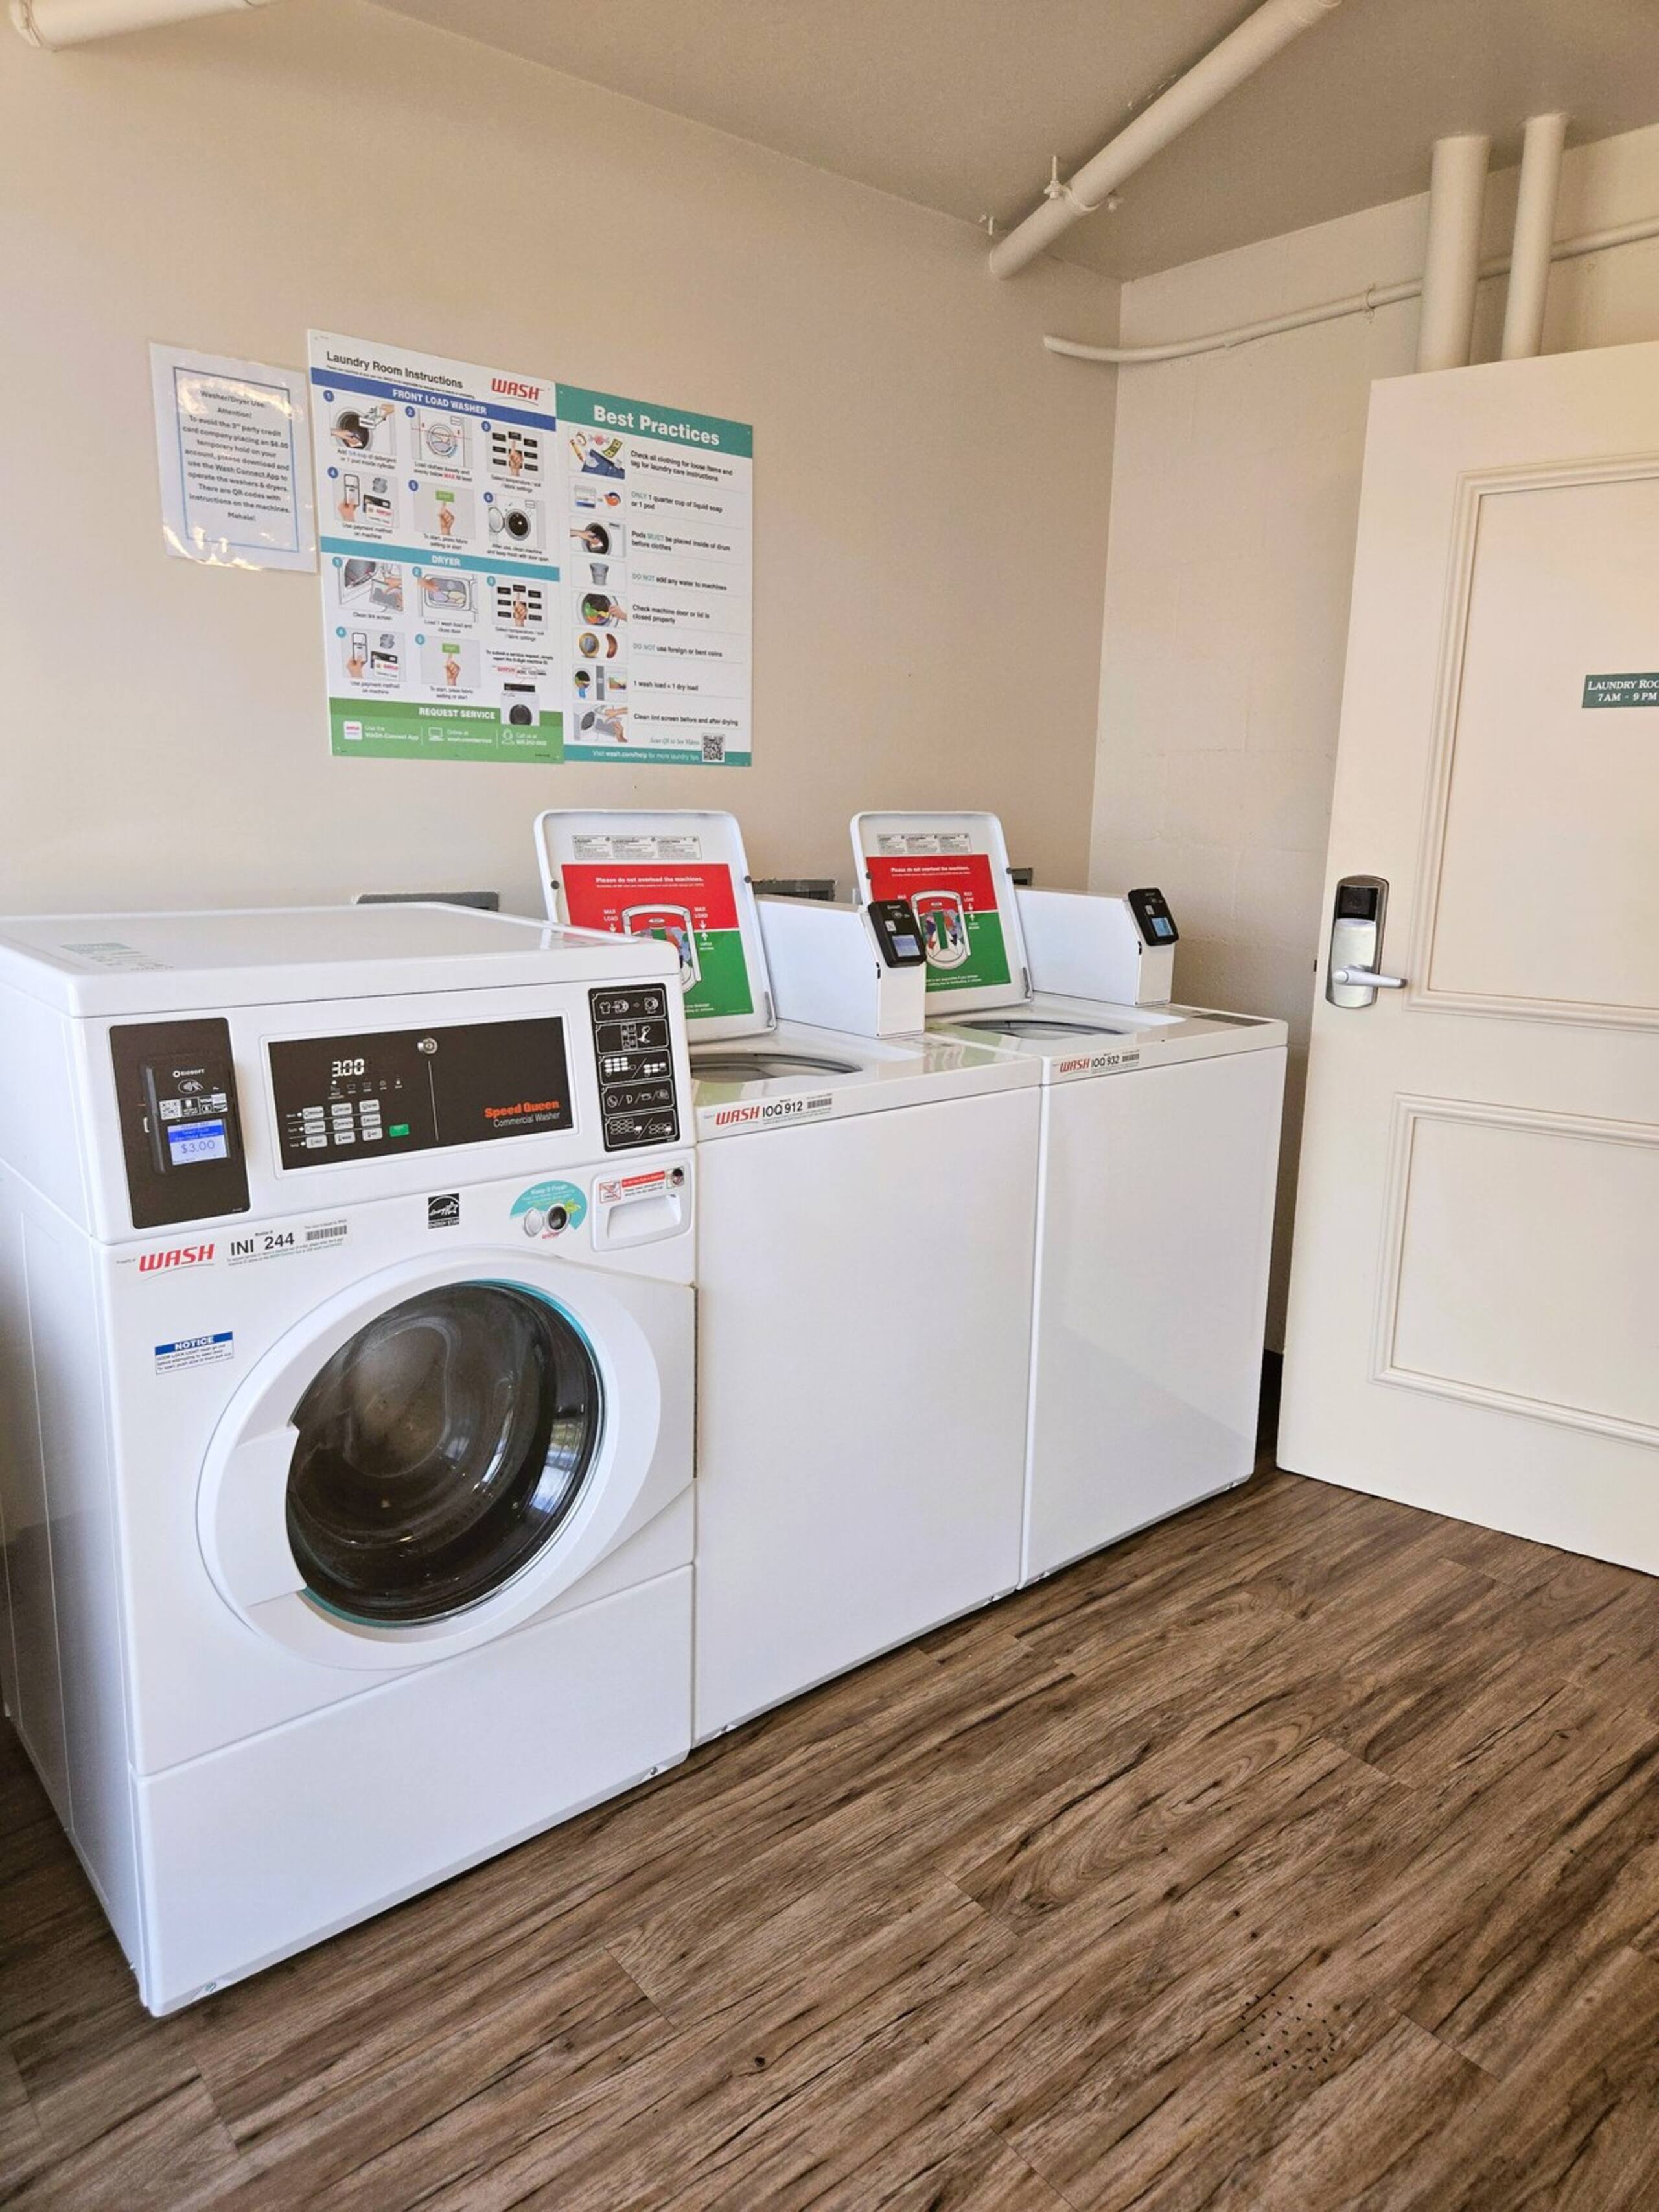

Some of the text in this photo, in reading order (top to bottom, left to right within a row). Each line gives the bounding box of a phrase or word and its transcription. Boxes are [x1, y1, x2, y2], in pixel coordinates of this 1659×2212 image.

[327, 351, 370, 371] Laundry
[372, 360, 403, 377] Room
[404, 367, 463, 389] Instructions
[491, 378, 539, 401] WASH
[392, 388, 423, 402] FRONT
[424, 393, 449, 408] LOAD
[450, 399, 487, 415] WASHER
[594, 405, 721, 446] Best Practices
[200, 430, 233, 441] company
[234, 435, 259, 445] placing
[197, 439, 233, 451] temporary
[235, 445, 251, 454] hold
[185, 449, 216, 460] account,
[217, 455, 240, 463] please
[242, 458, 276, 469] download
[631, 450, 649, 460] Check
[658, 456, 680, 467] clothing
[691, 462, 706, 471] loose
[215, 464, 235, 473] Wash
[236, 467, 265, 478] Connect
[266, 472, 279, 482] App
[631, 460, 640, 469] tag
[651, 463, 671, 474] laundry
[686, 471, 719, 482] instructions
[187, 472, 215, 481] operate
[229, 479, 259, 487] washers
[198, 483, 219, 492] There
[244, 491, 265, 499] codes
[189, 493, 232, 506] instructions
[632, 539, 672, 551] before clothes
[432, 555, 461, 566] DRYER
[702, 583, 727, 591] machines
[653, 615, 675, 625] properly
[668, 647, 688, 655] foreign
[1588, 681, 1638, 690] LAUNDRY
[1632, 692, 1640, 701] 9
[1641, 692, 1658, 701] PM
[419, 707, 496, 720] REQUEST SERVICE
[722, 719, 739, 727] drying
[332, 1058, 365, 1078] 3.00
[1060, 1058, 1090, 1073] WASH
[1107, 1055, 1120, 1065] 932
[485, 1101, 560, 1119] Speed Queen
[715, 1106, 760, 1126] WASH
[784, 1100, 804, 1113] 912
[493, 1112, 561, 1128] Commercial Washer
[181, 1139, 215, 1154] $3.00
[138, 1244, 215, 1272] WASH
[230, 1239, 255, 1256] INI
[264, 1233, 296, 1250] 244
[175, 1336, 215, 1351] NOTICE
